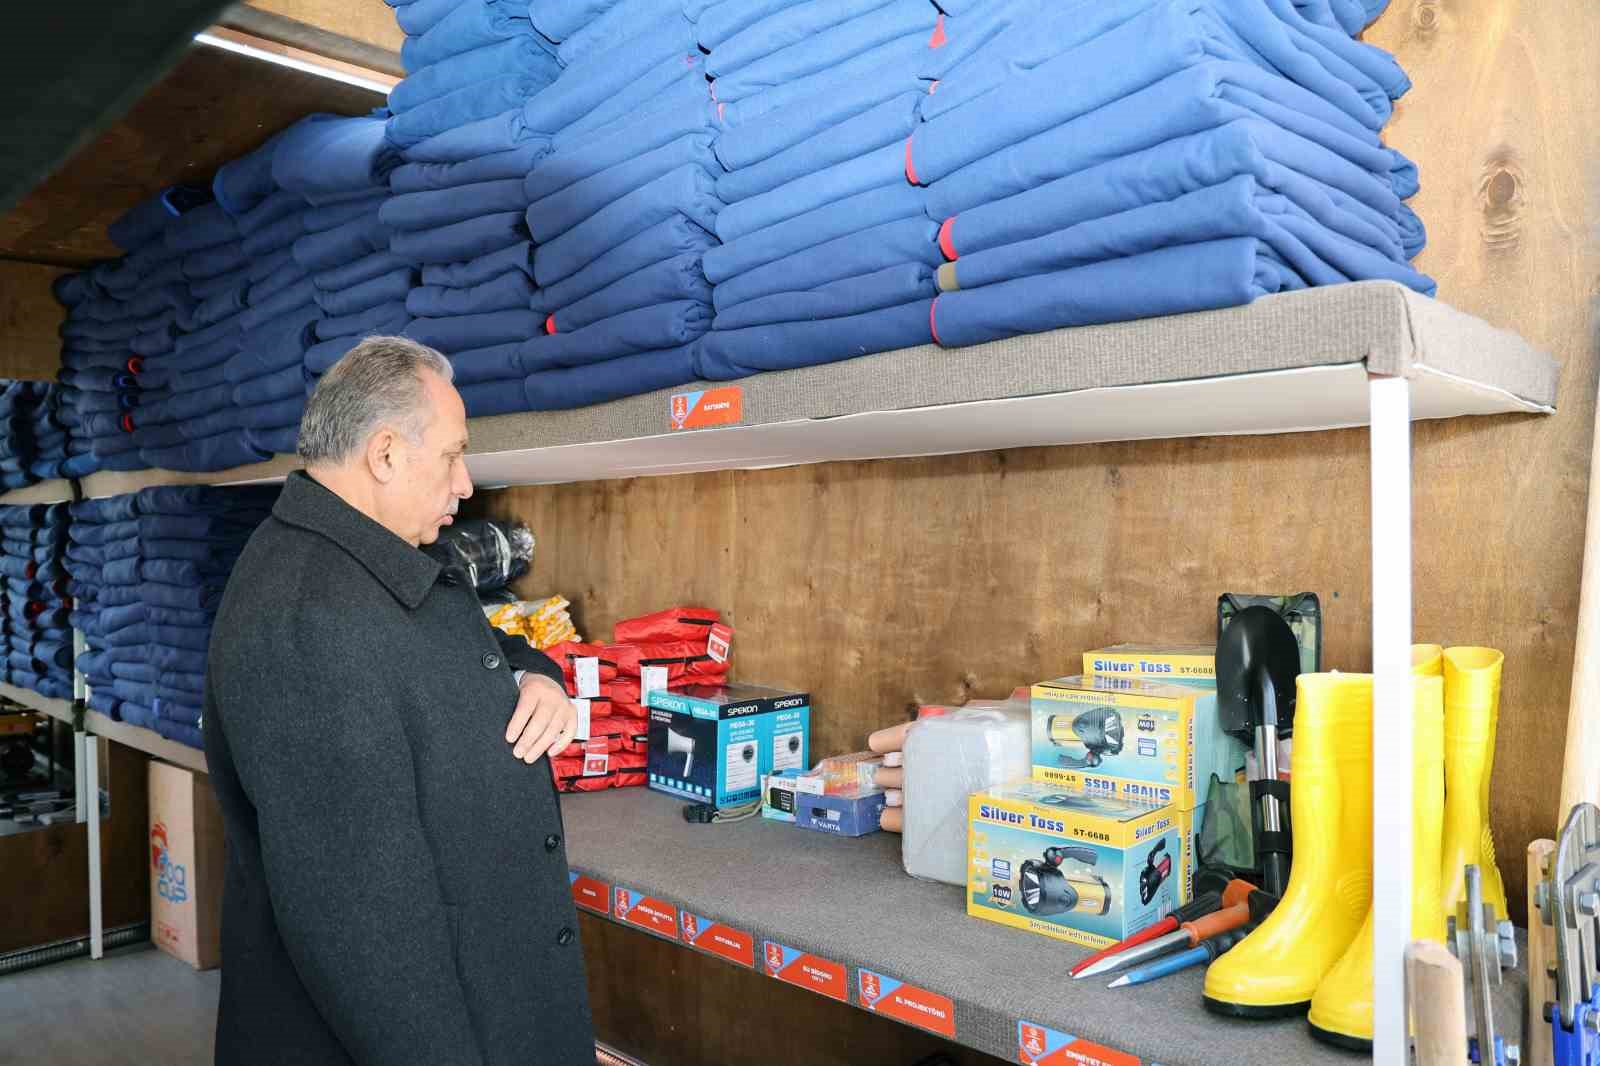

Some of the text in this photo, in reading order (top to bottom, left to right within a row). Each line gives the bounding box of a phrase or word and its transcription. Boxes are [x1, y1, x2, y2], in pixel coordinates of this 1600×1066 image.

[1093, 660, 1135, 673] Silver
[1140, 661, 1172, 673] Toss
[774, 697, 803, 709] SPEKON
[727, 704, 758, 716] SPEKON
[1084, 777, 1117, 792] Toss
[1123, 784, 1170, 800] Silver
[980, 805, 1025, 825] Silver
[1030, 813, 1064, 833] Toss
[819, 821, 841, 832] VARTA
[1135, 818, 1171, 840] Silver Toss
[993, 887, 1011, 899] 10W
